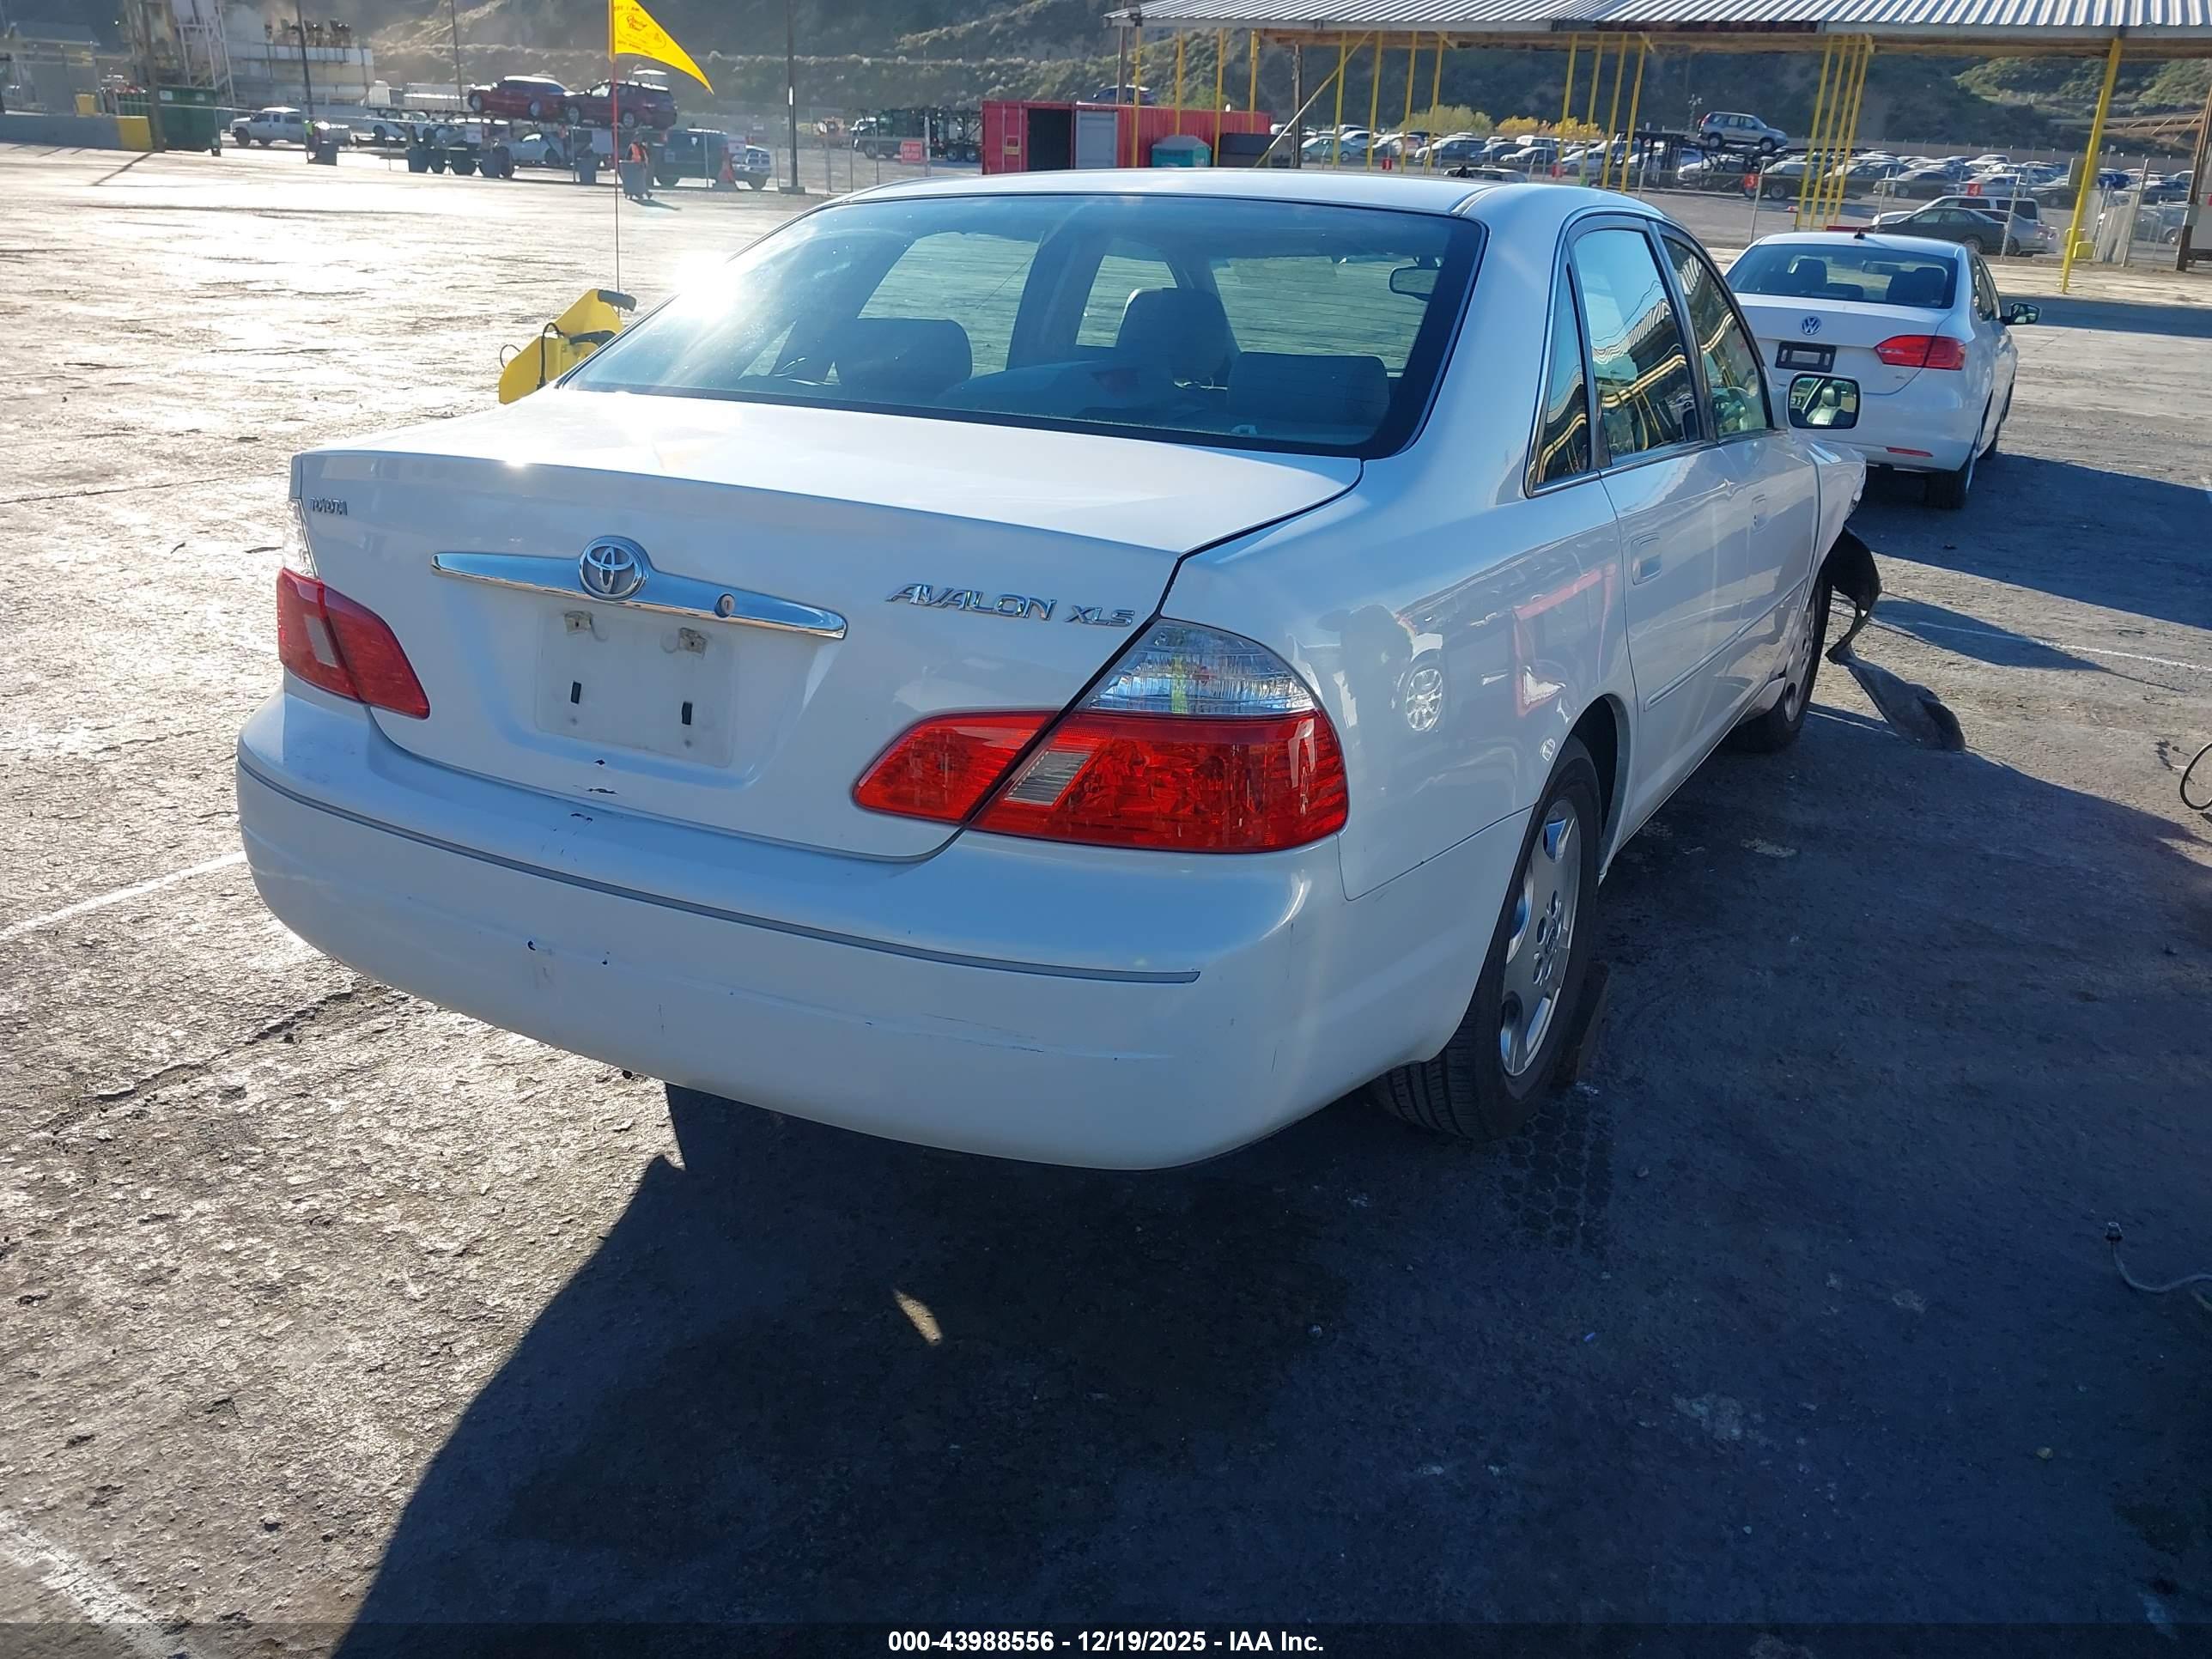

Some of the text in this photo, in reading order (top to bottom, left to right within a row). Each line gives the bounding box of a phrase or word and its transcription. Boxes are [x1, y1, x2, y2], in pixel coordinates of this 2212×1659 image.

[1747, 175, 1755, 186] 3
[1969, 184, 1979, 196] 4
[309, 497, 348, 516] TOYOTA
[885, 583, 1135, 628] AVALON XLS
